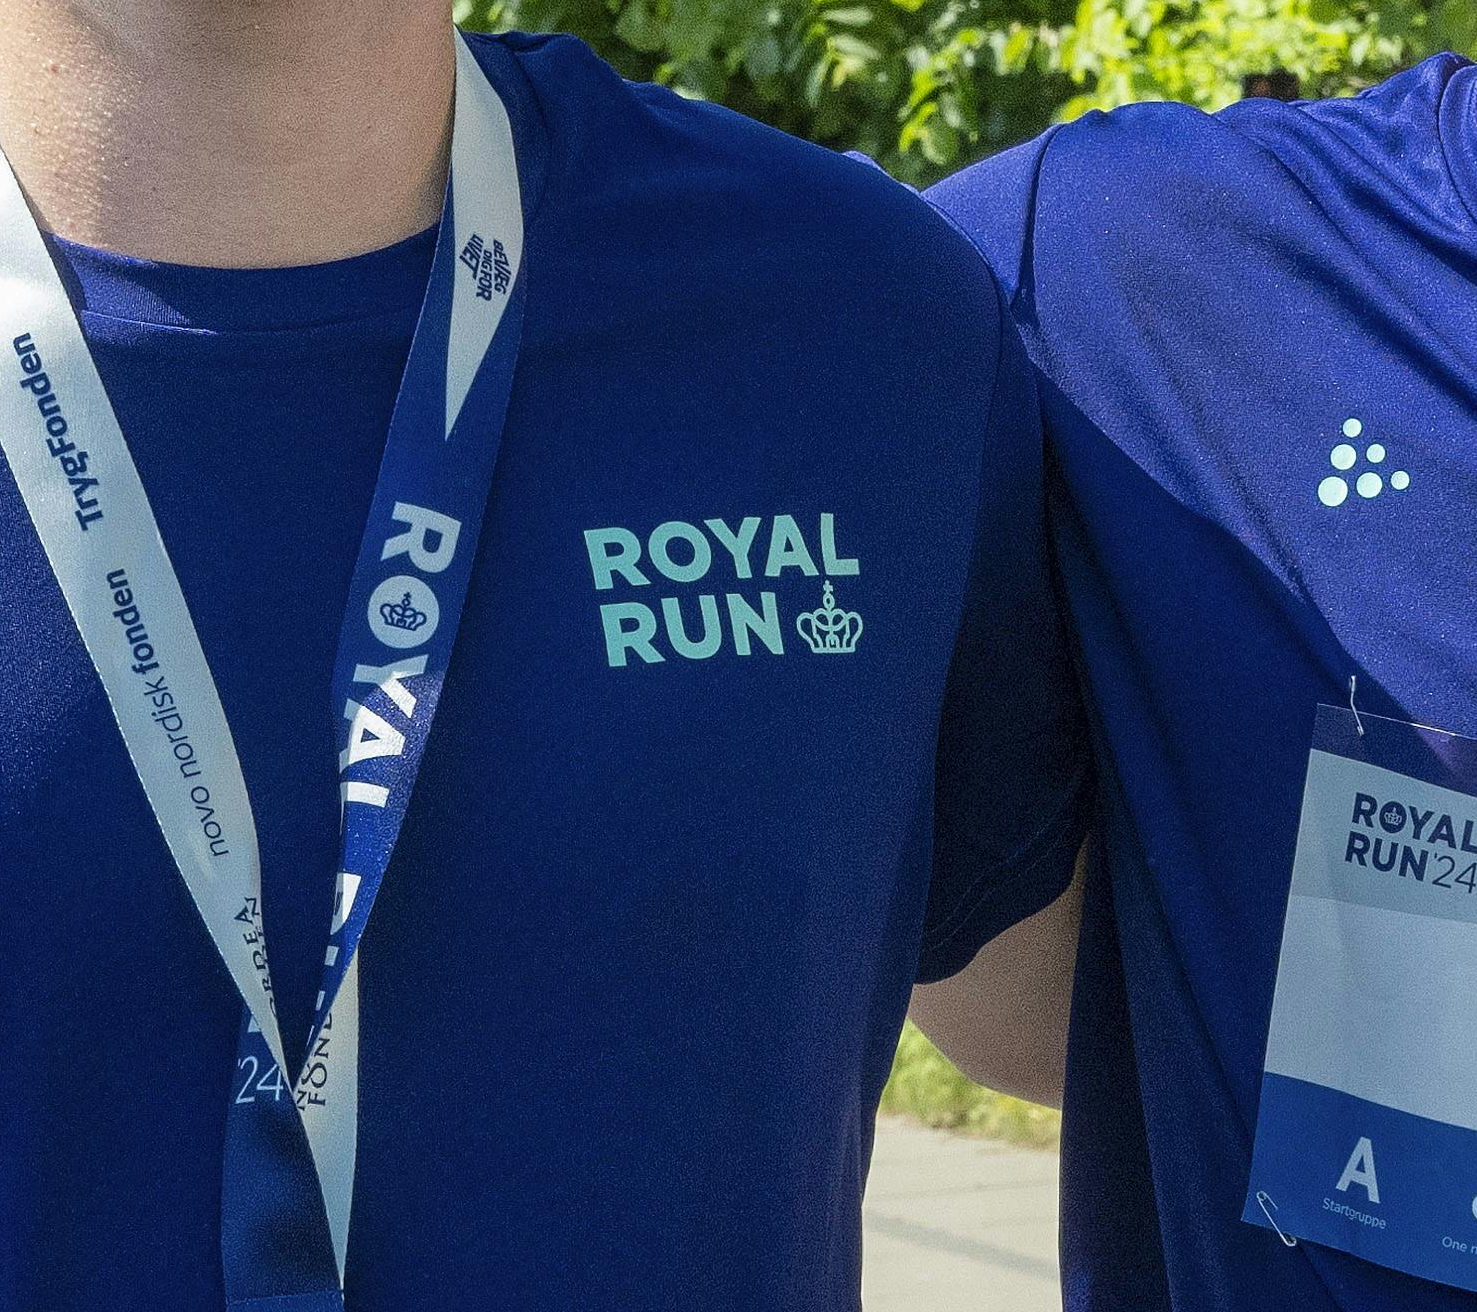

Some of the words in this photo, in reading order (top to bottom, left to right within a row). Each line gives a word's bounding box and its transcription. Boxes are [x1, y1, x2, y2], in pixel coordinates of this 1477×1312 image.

[13, 333, 104, 531] TrygFonden
[584, 513, 859, 589] ROYAL
[107, 568, 160, 674] fonden
[600, 591, 784, 667] RUN
[144, 674, 201, 779] nordisk
[191, 785, 228, 857] novo
[1335, 1136, 1380, 1204] A
[1322, 1197, 1387, 1230] Startgruppe
[1442, 1236, 1468, 1252] One
